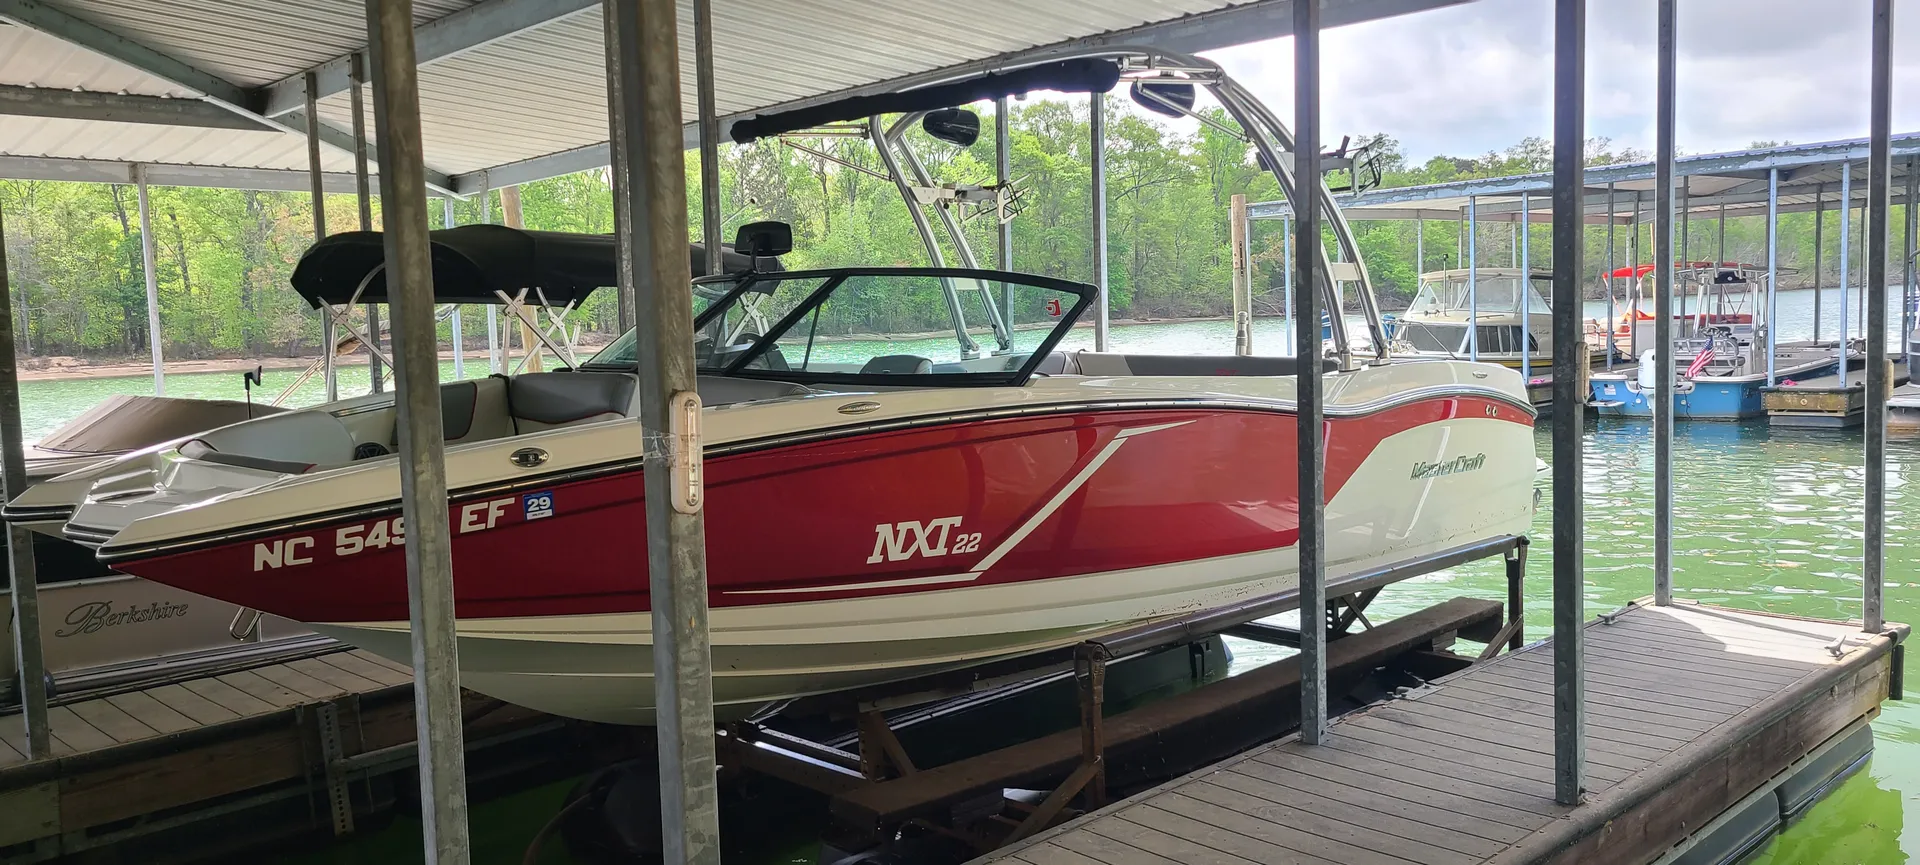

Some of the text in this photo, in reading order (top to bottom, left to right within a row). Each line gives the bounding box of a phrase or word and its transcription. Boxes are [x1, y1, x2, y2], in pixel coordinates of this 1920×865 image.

[527, 496, 551, 511] 29
[254, 536, 314, 572] NC
[460, 498, 515, 534] EF
[866, 516, 982, 564] NXT 22
[55, 601, 189, 638] Berkshire
